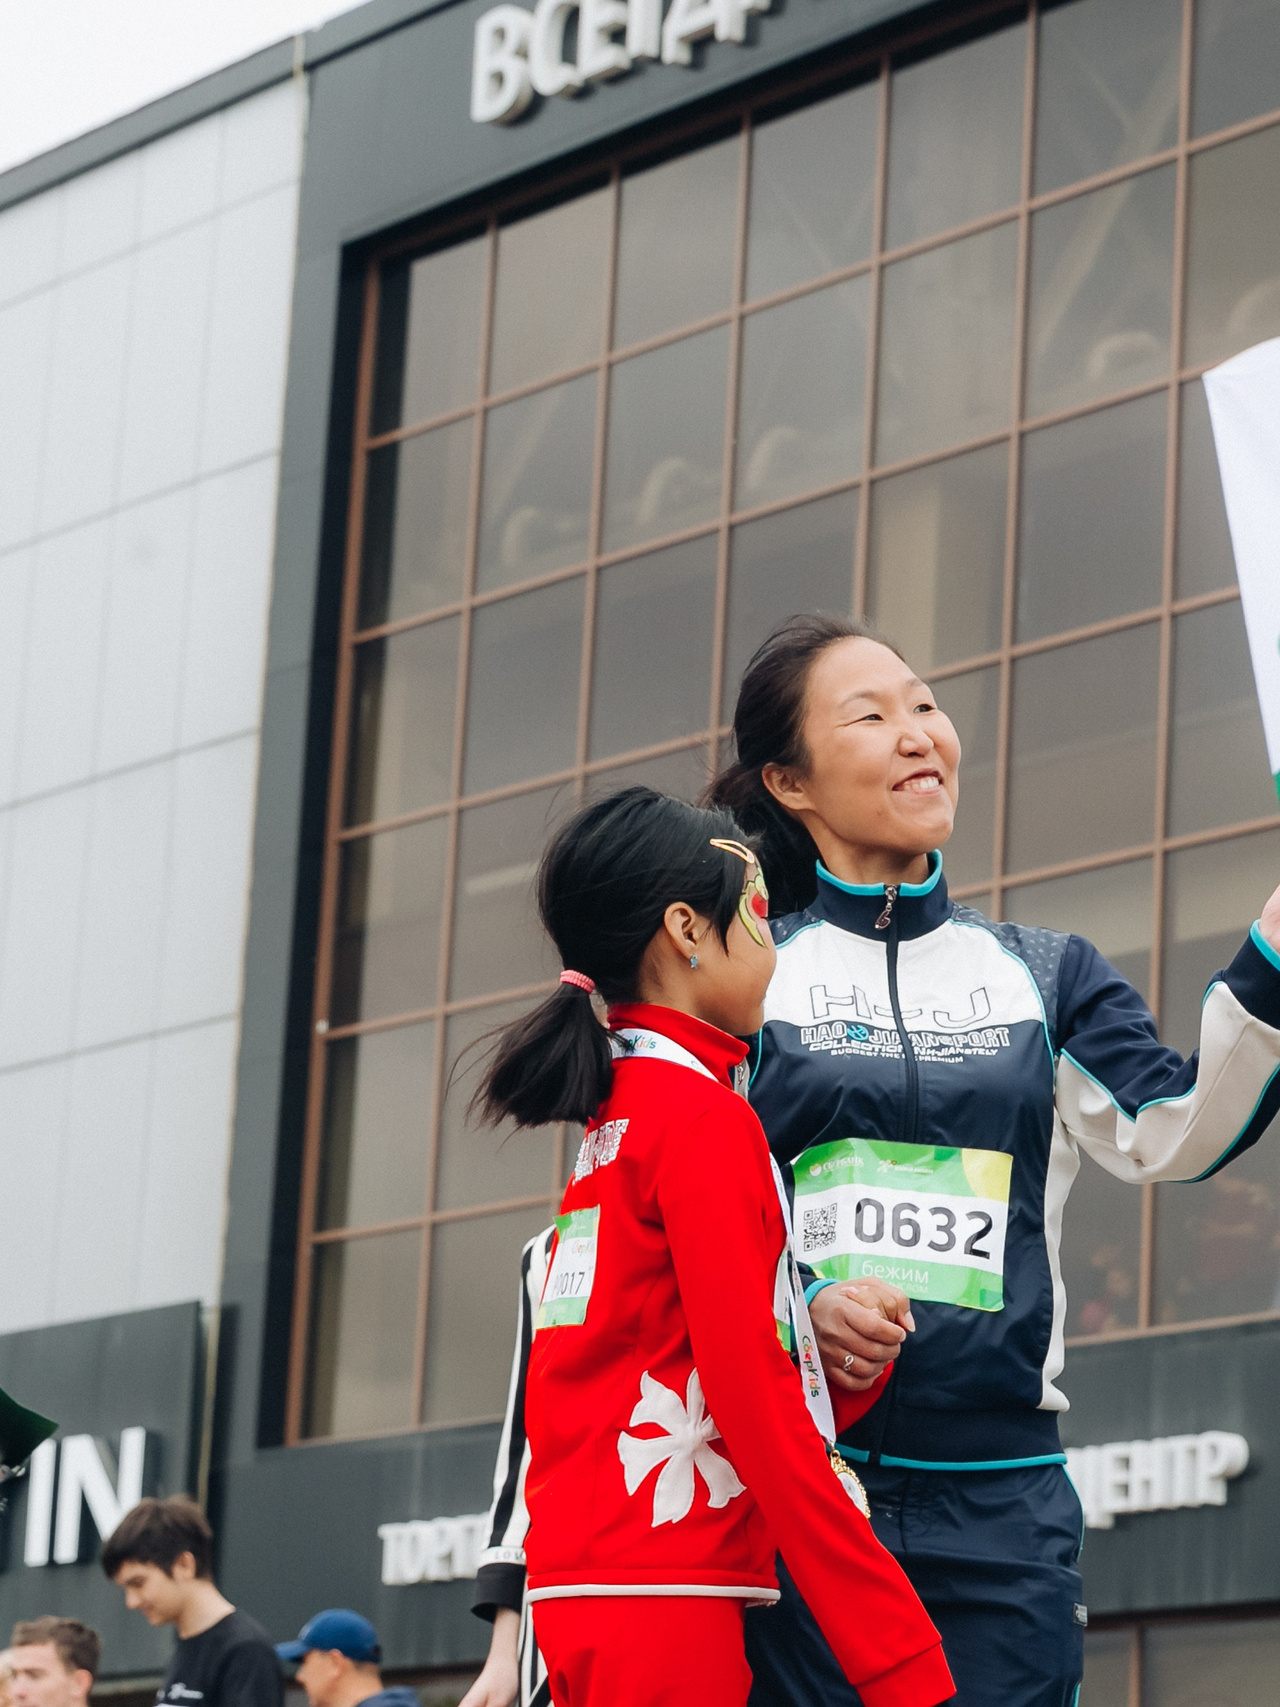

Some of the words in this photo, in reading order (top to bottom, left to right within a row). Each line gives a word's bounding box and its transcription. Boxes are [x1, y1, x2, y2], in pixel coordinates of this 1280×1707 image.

[801, 1020, 847, 1045] HAO
[854, 1197, 993, 1260] 0632
[862, 1259, 929, 1284] бежим
[377, 1511, 490, 1586] ТОРГ
